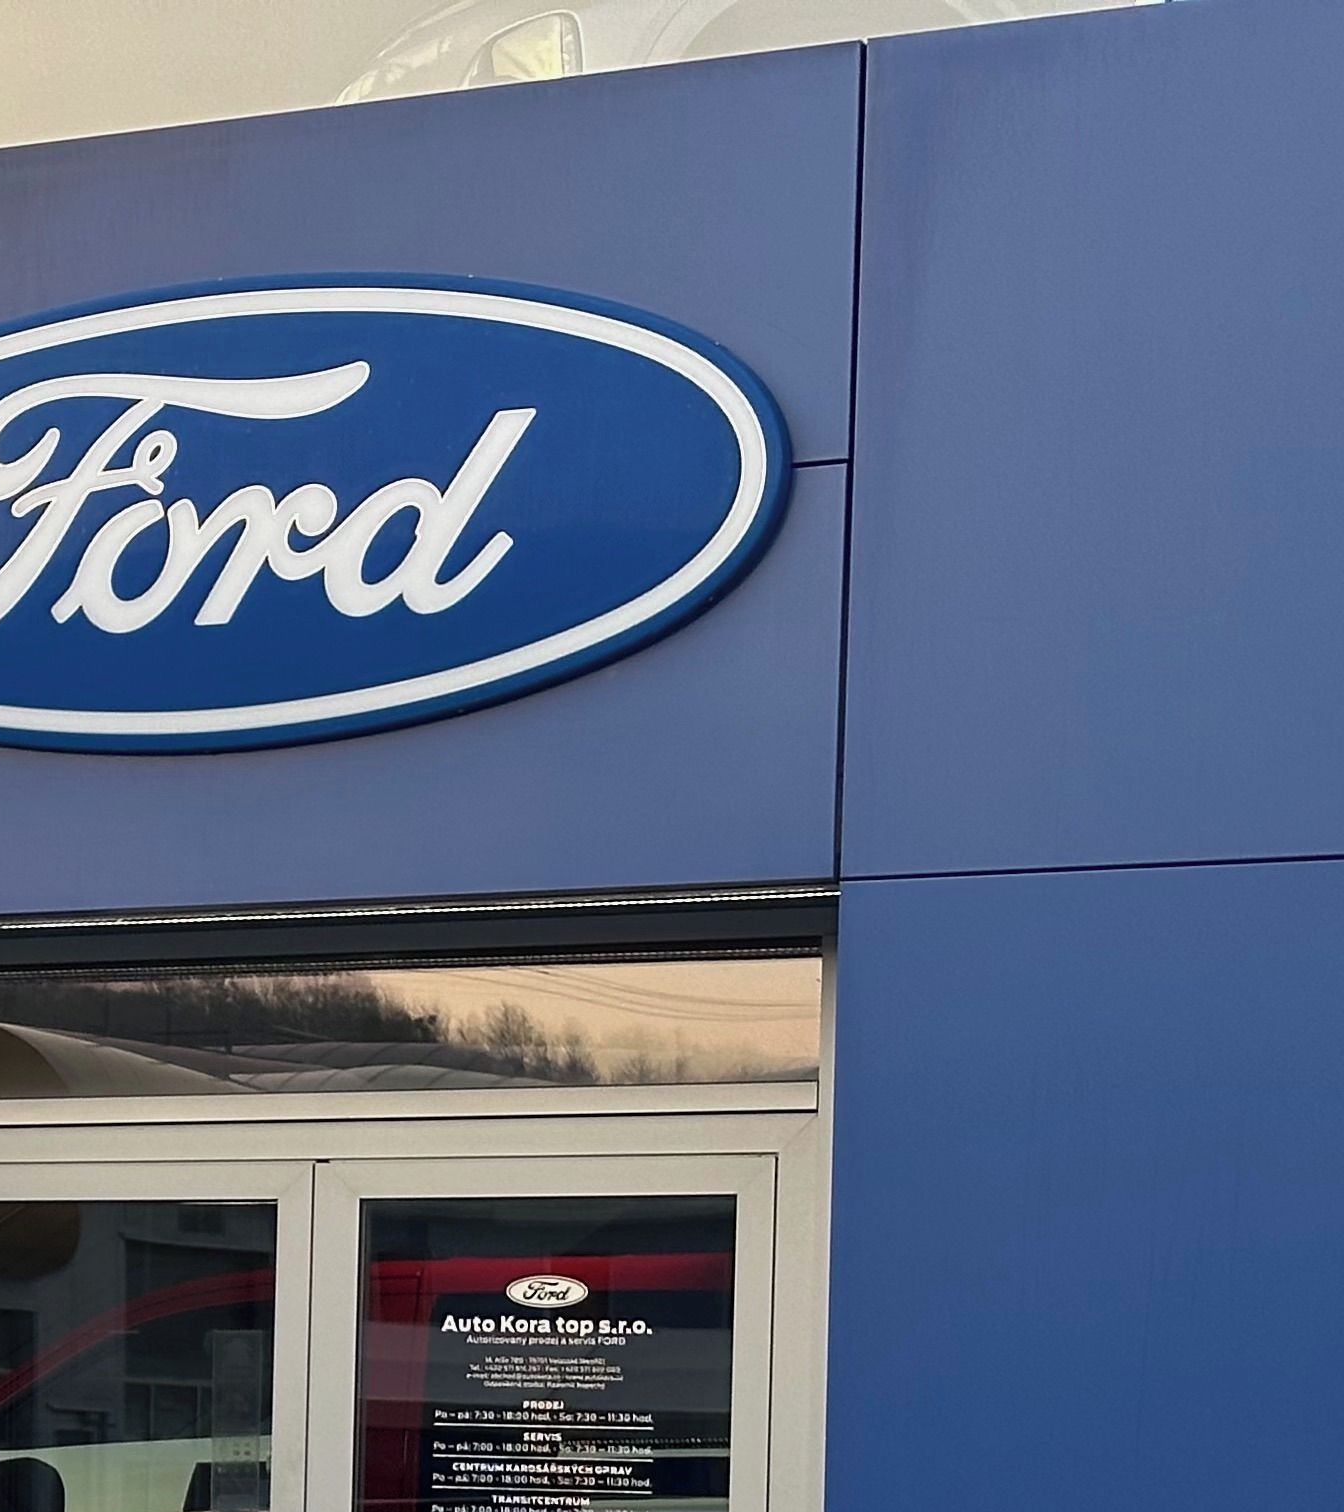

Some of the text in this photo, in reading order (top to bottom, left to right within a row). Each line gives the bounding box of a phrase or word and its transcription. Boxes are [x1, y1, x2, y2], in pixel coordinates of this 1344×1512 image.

[522, 1280, 571, 1301] Ford
[441, 1315, 653, 1336] Auto Kora top s.r.o.
[597, 1337, 626, 1346] FORD
[522, 1400, 564, 1410] PRODEJ
[523, 1432, 562, 1442] SERVIS
[452, 1462, 504, 1472] CENTRUM
[594, 1466, 632, 1475] OPRAV
